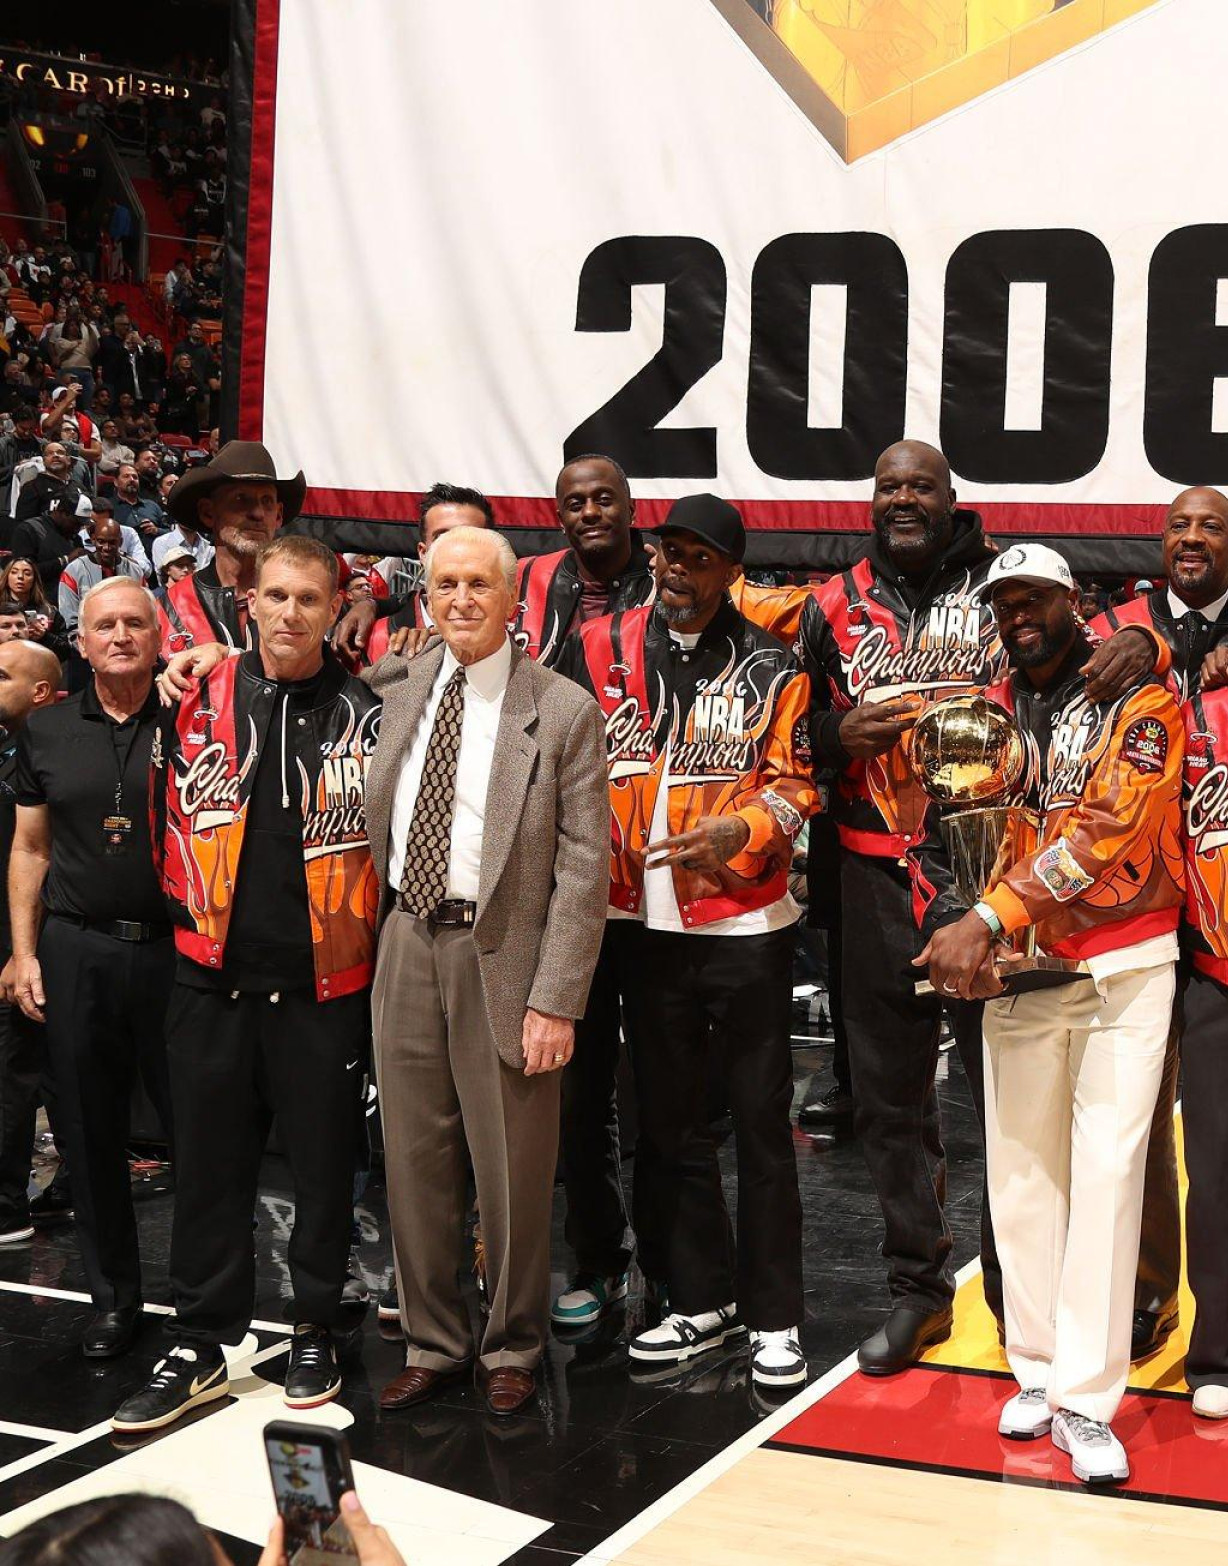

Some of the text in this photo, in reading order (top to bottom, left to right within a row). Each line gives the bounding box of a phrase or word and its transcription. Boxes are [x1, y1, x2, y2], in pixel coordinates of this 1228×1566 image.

[929, 607, 980, 650] NBA
[841, 626, 988, 697] Champions
[694, 695, 745, 744] NBA
[323, 756, 373, 806] NB
